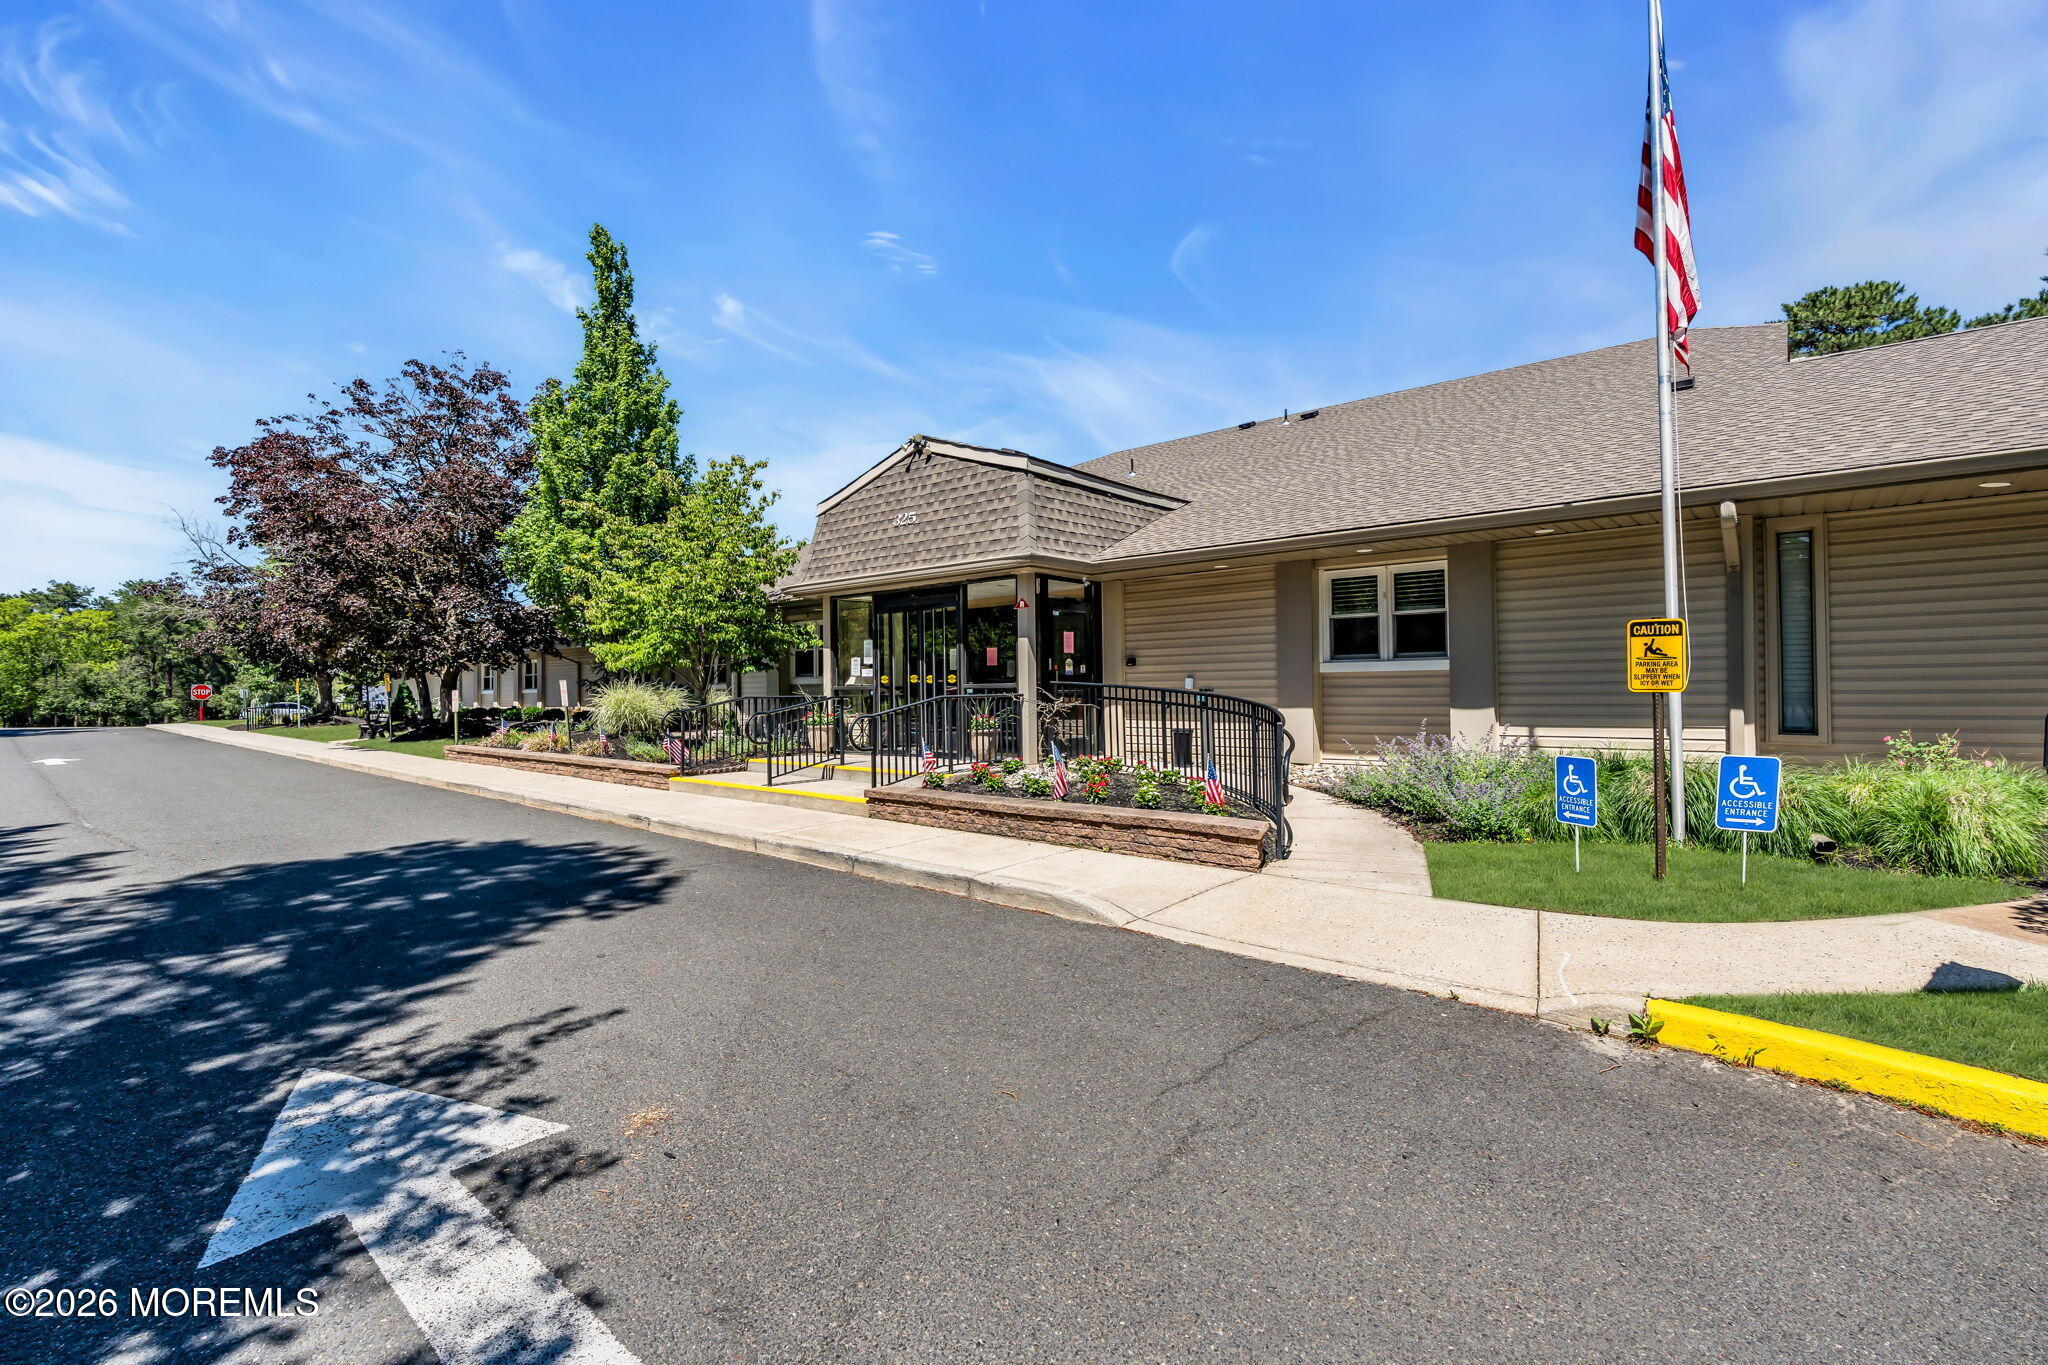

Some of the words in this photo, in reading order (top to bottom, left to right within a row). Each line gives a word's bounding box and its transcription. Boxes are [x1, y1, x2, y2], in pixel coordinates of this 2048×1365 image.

[893, 511, 917, 527] 325
[1633, 624, 1679, 635] CAUTION
[1559, 795, 1593, 806] ACCESSIBLE
[1721, 799, 1773, 809] ACCESSIBLE
[1561, 803, 1591, 813] ENTRANCE
[1725, 807, 1768, 817] ENTRANCE
